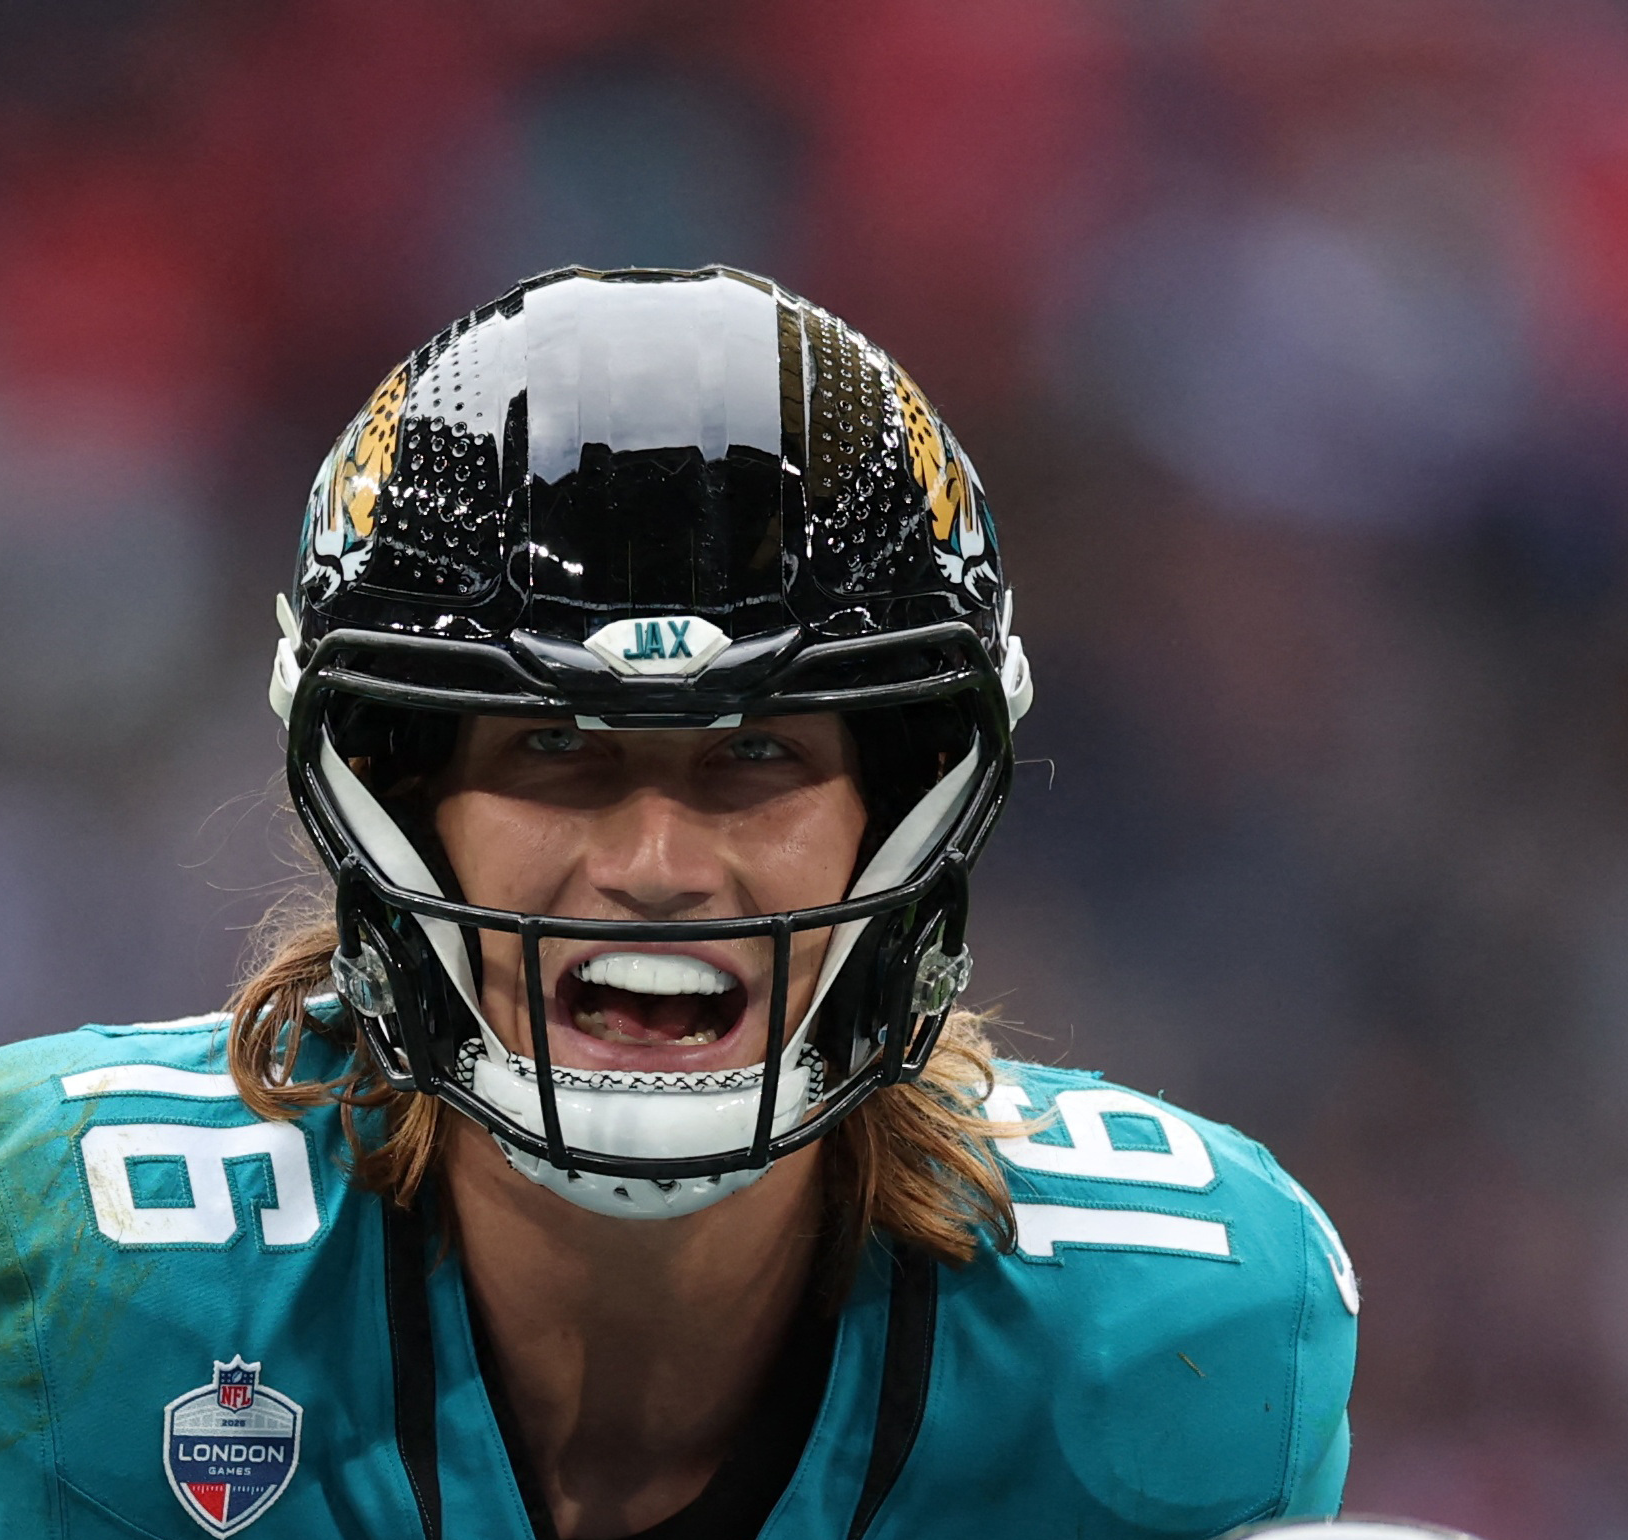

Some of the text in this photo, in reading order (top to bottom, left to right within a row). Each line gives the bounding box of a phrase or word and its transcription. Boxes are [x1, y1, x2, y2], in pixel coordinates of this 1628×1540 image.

[623, 620, 693, 660] JAX
[60, 1063, 322, 1247] 16
[976, 1084, 1232, 1258] 16
[220, 1385, 252, 1409] NFL
[178, 1443, 285, 1464] LONDON
[208, 1466, 252, 1476] GAMES
